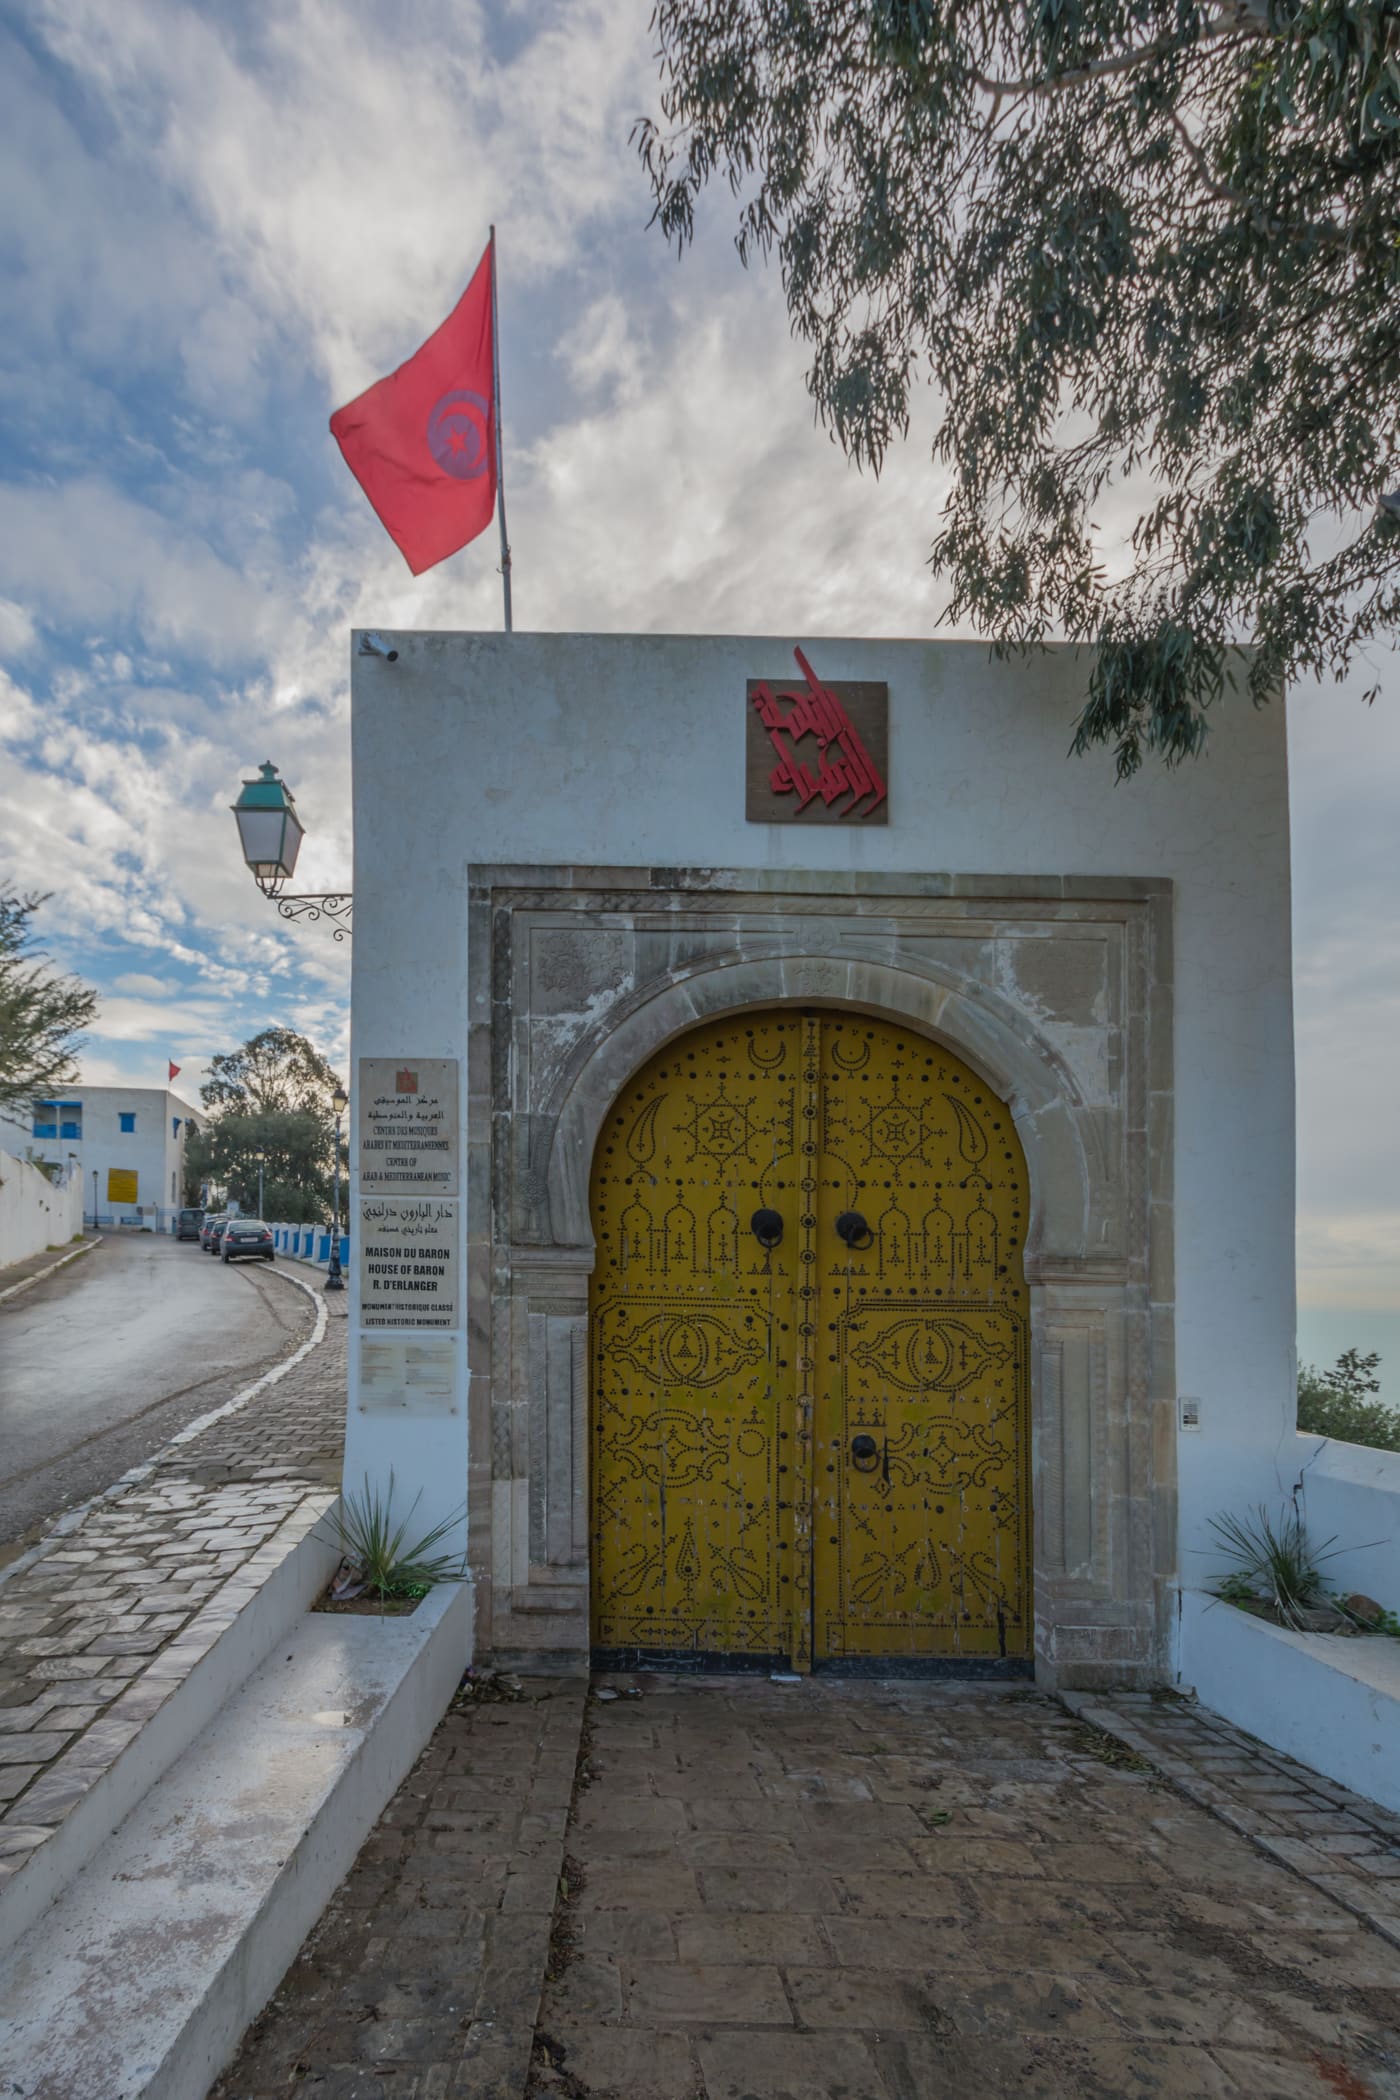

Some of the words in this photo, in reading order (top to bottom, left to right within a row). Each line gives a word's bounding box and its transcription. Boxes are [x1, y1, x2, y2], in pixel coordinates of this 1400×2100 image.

[416, 1110, 444, 1121] العربية
[373, 1126, 395, 1135] CENTRE
[396, 1126, 408, 1135] DES
[408, 1126, 438, 1137] MUSIQUES
[363, 1140, 384, 1150] ARABES
[384, 1140, 392, 1150] ET
[386, 1158, 408, 1167] CENTRE
[408, 1158, 417, 1167] OF
[363, 1172, 378, 1181] ARAB
[400, 1202, 432, 1222] البارون
[433, 1203, 453, 1223] دار
[365, 1247, 402, 1258] MAISON
[404, 1248, 416, 1259] DU
[419, 1248, 450, 1260] BARON
[368, 1264, 398, 1275] HOUSE
[400, 1264, 412, 1275] OF
[413, 1265, 445, 1276] BARON
[373, 1279, 381, 1290] R.
[383, 1280, 438, 1291] D'ERLANGER
[362, 1303, 394, 1311] MONUMENT
[395, 1303, 429, 1312] HISTORIQUE
[365, 1318, 385, 1326] LISTED
[387, 1318, 415, 1326] HISTORIC
[416, 1318, 451, 1326] MONUMENT
